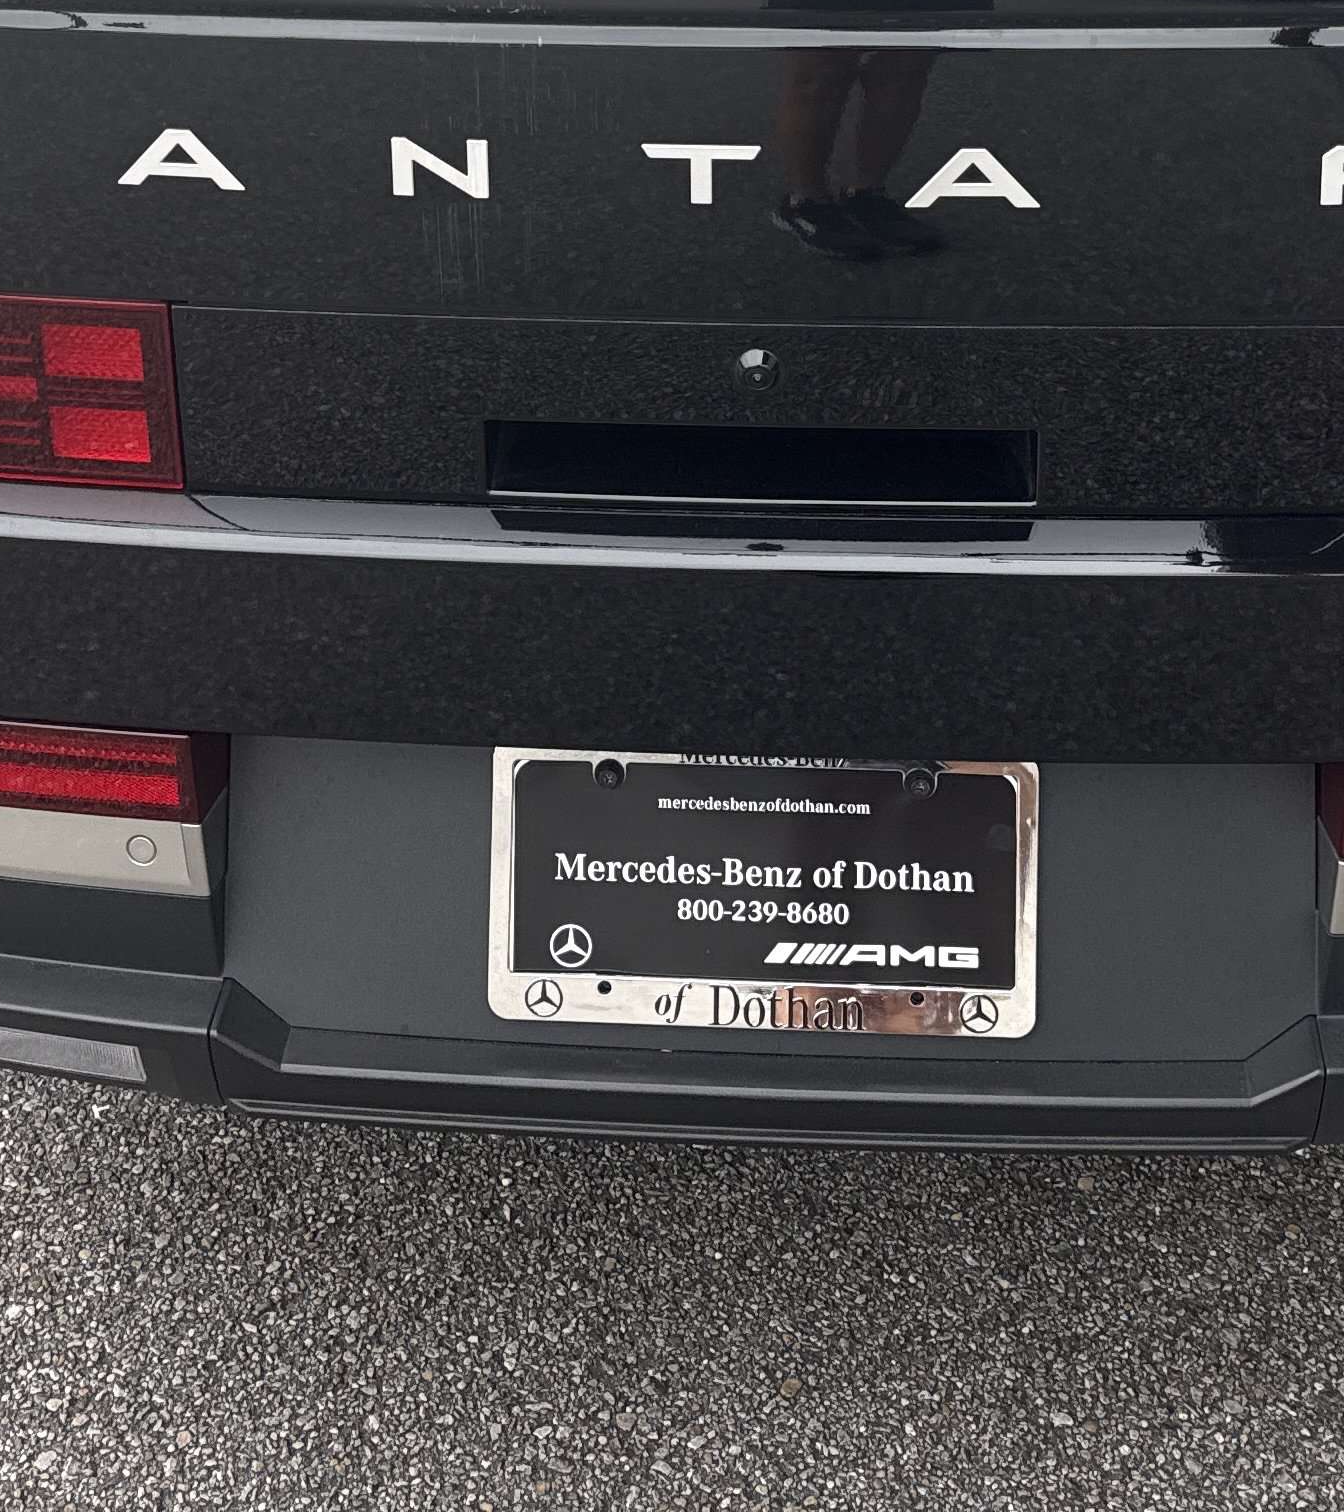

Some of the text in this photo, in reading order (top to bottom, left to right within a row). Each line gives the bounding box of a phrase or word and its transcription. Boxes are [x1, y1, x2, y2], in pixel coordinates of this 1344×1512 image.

[657, 795, 872, 816] mercedesbenzofdothan.com
[553, 851, 976, 894] Mercedes-Benz of Dothan
[676, 897, 851, 926] 800-239-8680
[654, 982, 867, 1033] of Dothan
